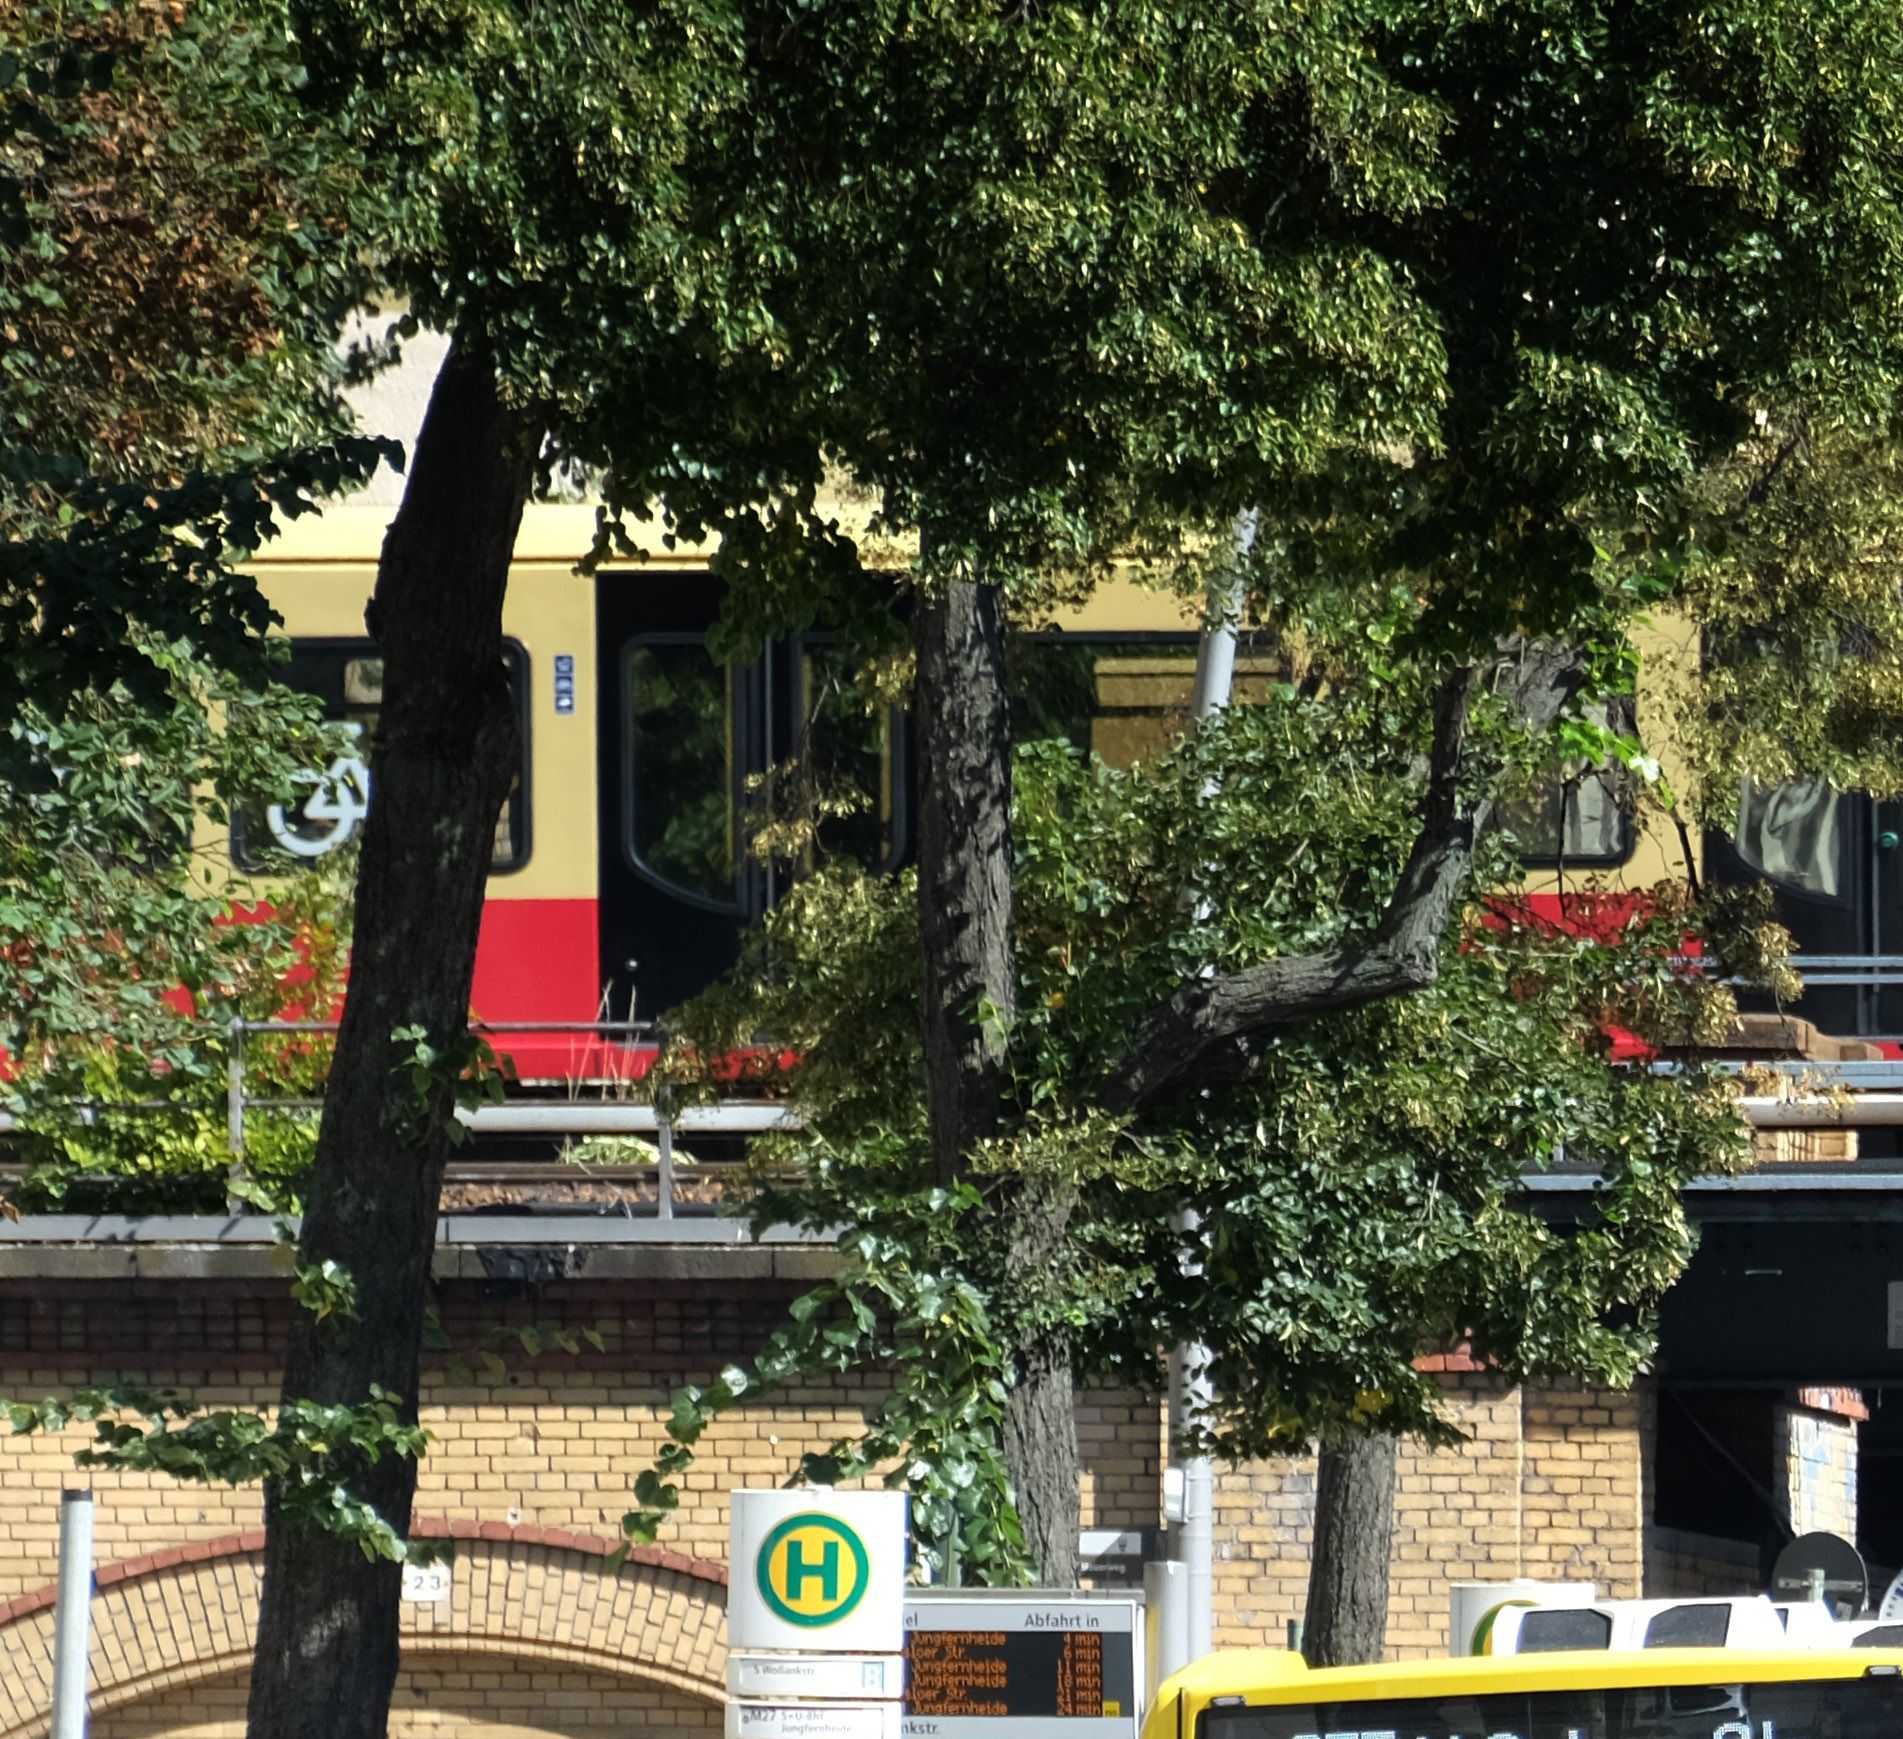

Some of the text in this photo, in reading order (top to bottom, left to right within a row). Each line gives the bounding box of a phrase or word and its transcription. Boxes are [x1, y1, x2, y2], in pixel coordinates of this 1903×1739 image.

[786, 1540, 839, 1601] H
[413, 1575, 441, 1591] 23
[1024, 1612, 1081, 1628] Abfahrt
[1086, 1613, 1100, 1628] in
[1075, 1633, 1100, 1646] min
[1075, 1646, 1100, 1659] min
[1075, 1660, 1101, 1673] min
[1075, 1674, 1101, 1687] min
[1075, 1688, 1101, 1701] min
[1076, 1702, 1101, 1715] min
[902, 1721, 940, 1736] nkstr.
